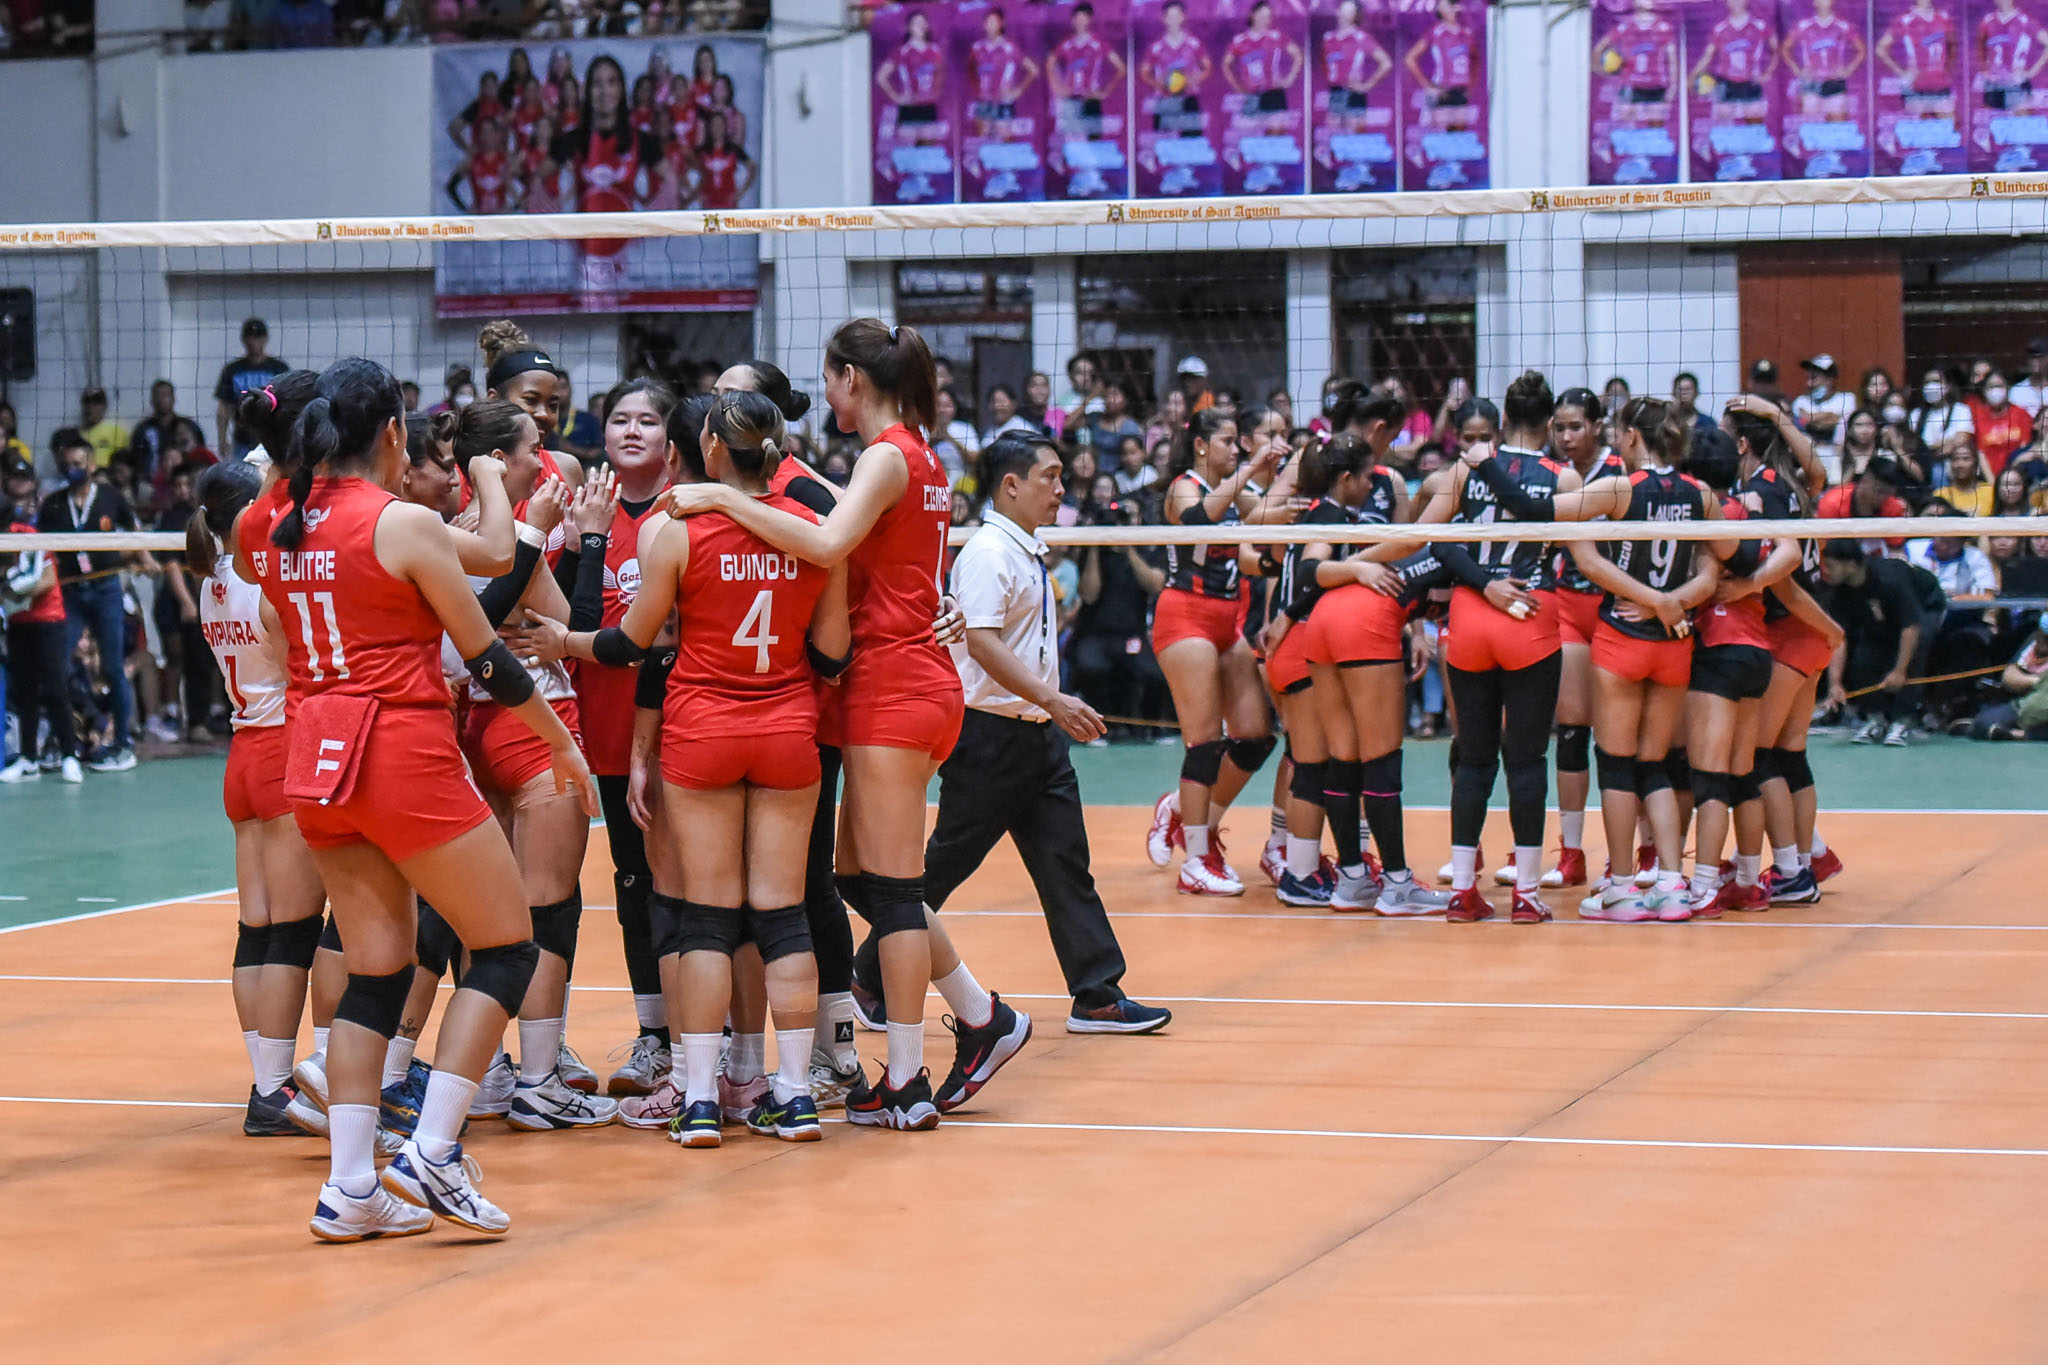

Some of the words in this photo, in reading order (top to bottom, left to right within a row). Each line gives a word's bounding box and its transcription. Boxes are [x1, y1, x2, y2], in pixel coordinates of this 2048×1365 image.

[1553, 194, 1616, 207] University
[1619, 192, 1630, 204] of
[1633, 191, 1659, 203] San
[1663, 189, 1712, 204] Agustin
[724, 217, 782, 229] University
[784, 215, 795, 227] of
[798, 215, 821, 227] San
[824, 214, 873, 228] Agustin
[1128, 207, 1189, 220] University
[1192, 206, 1202, 218] of
[1205, 205, 1231, 218] San
[1234, 204, 1281, 219] Agustin
[21, 232, 29, 241] of
[31, 231, 54, 242] San
[56, 230, 96, 243] Agustin
[336, 224, 391, 237] University
[394, 224, 402, 236] of
[406, 224, 428, 236] San
[432, 223, 474, 237] Agustin
[1646, 501, 1692, 521] LAURE
[280, 550, 336, 581] BUITRE
[1648, 539, 1678, 588] 9
[288, 591, 350, 682] 11
[731, 590, 779, 673] 4
[224, 655, 248, 719] 1
